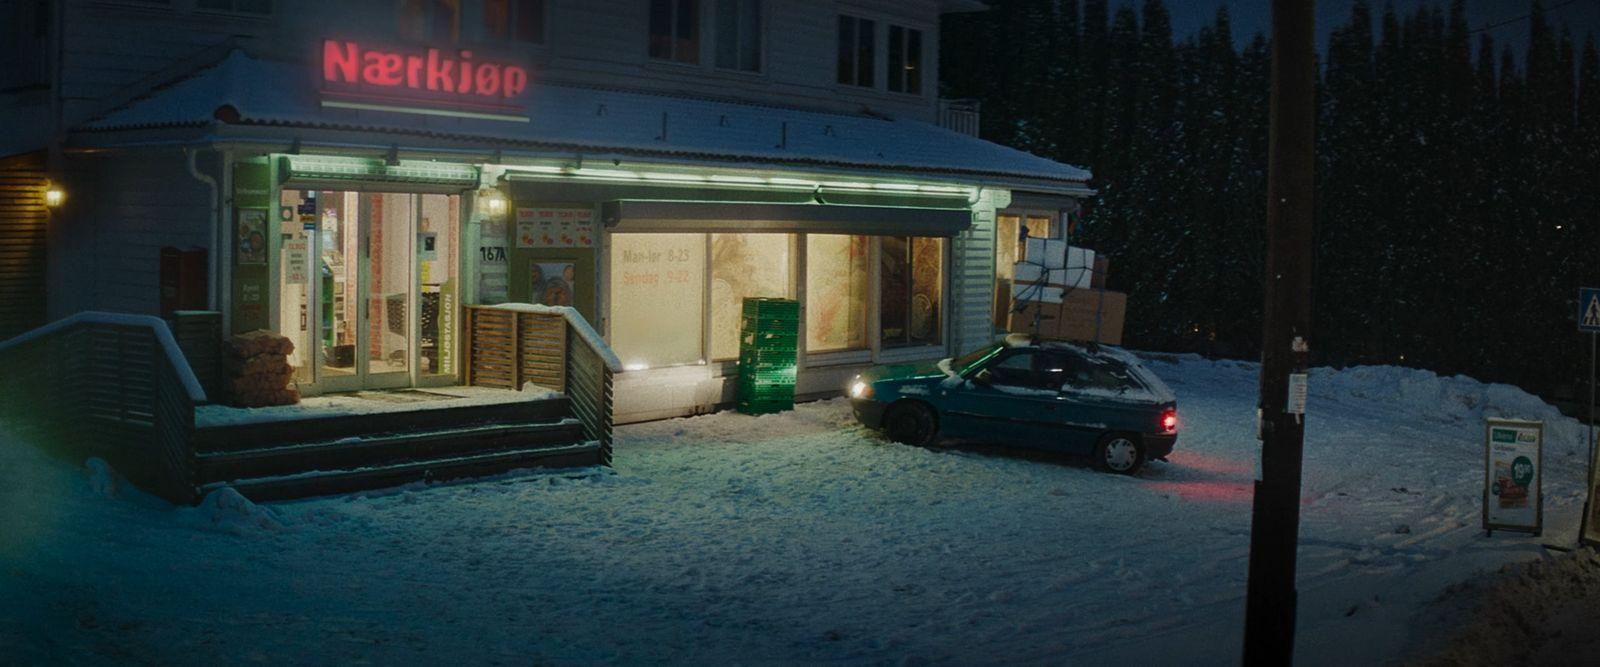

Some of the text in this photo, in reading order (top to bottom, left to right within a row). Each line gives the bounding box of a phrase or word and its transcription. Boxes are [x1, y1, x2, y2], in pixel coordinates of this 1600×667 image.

[323, 40, 527, 97] Nærkjøp
[480, 246, 507, 261] 167A
[667, 248, 690, 262] 8-23
[443, 294, 452, 374] MILJØSTASJON
